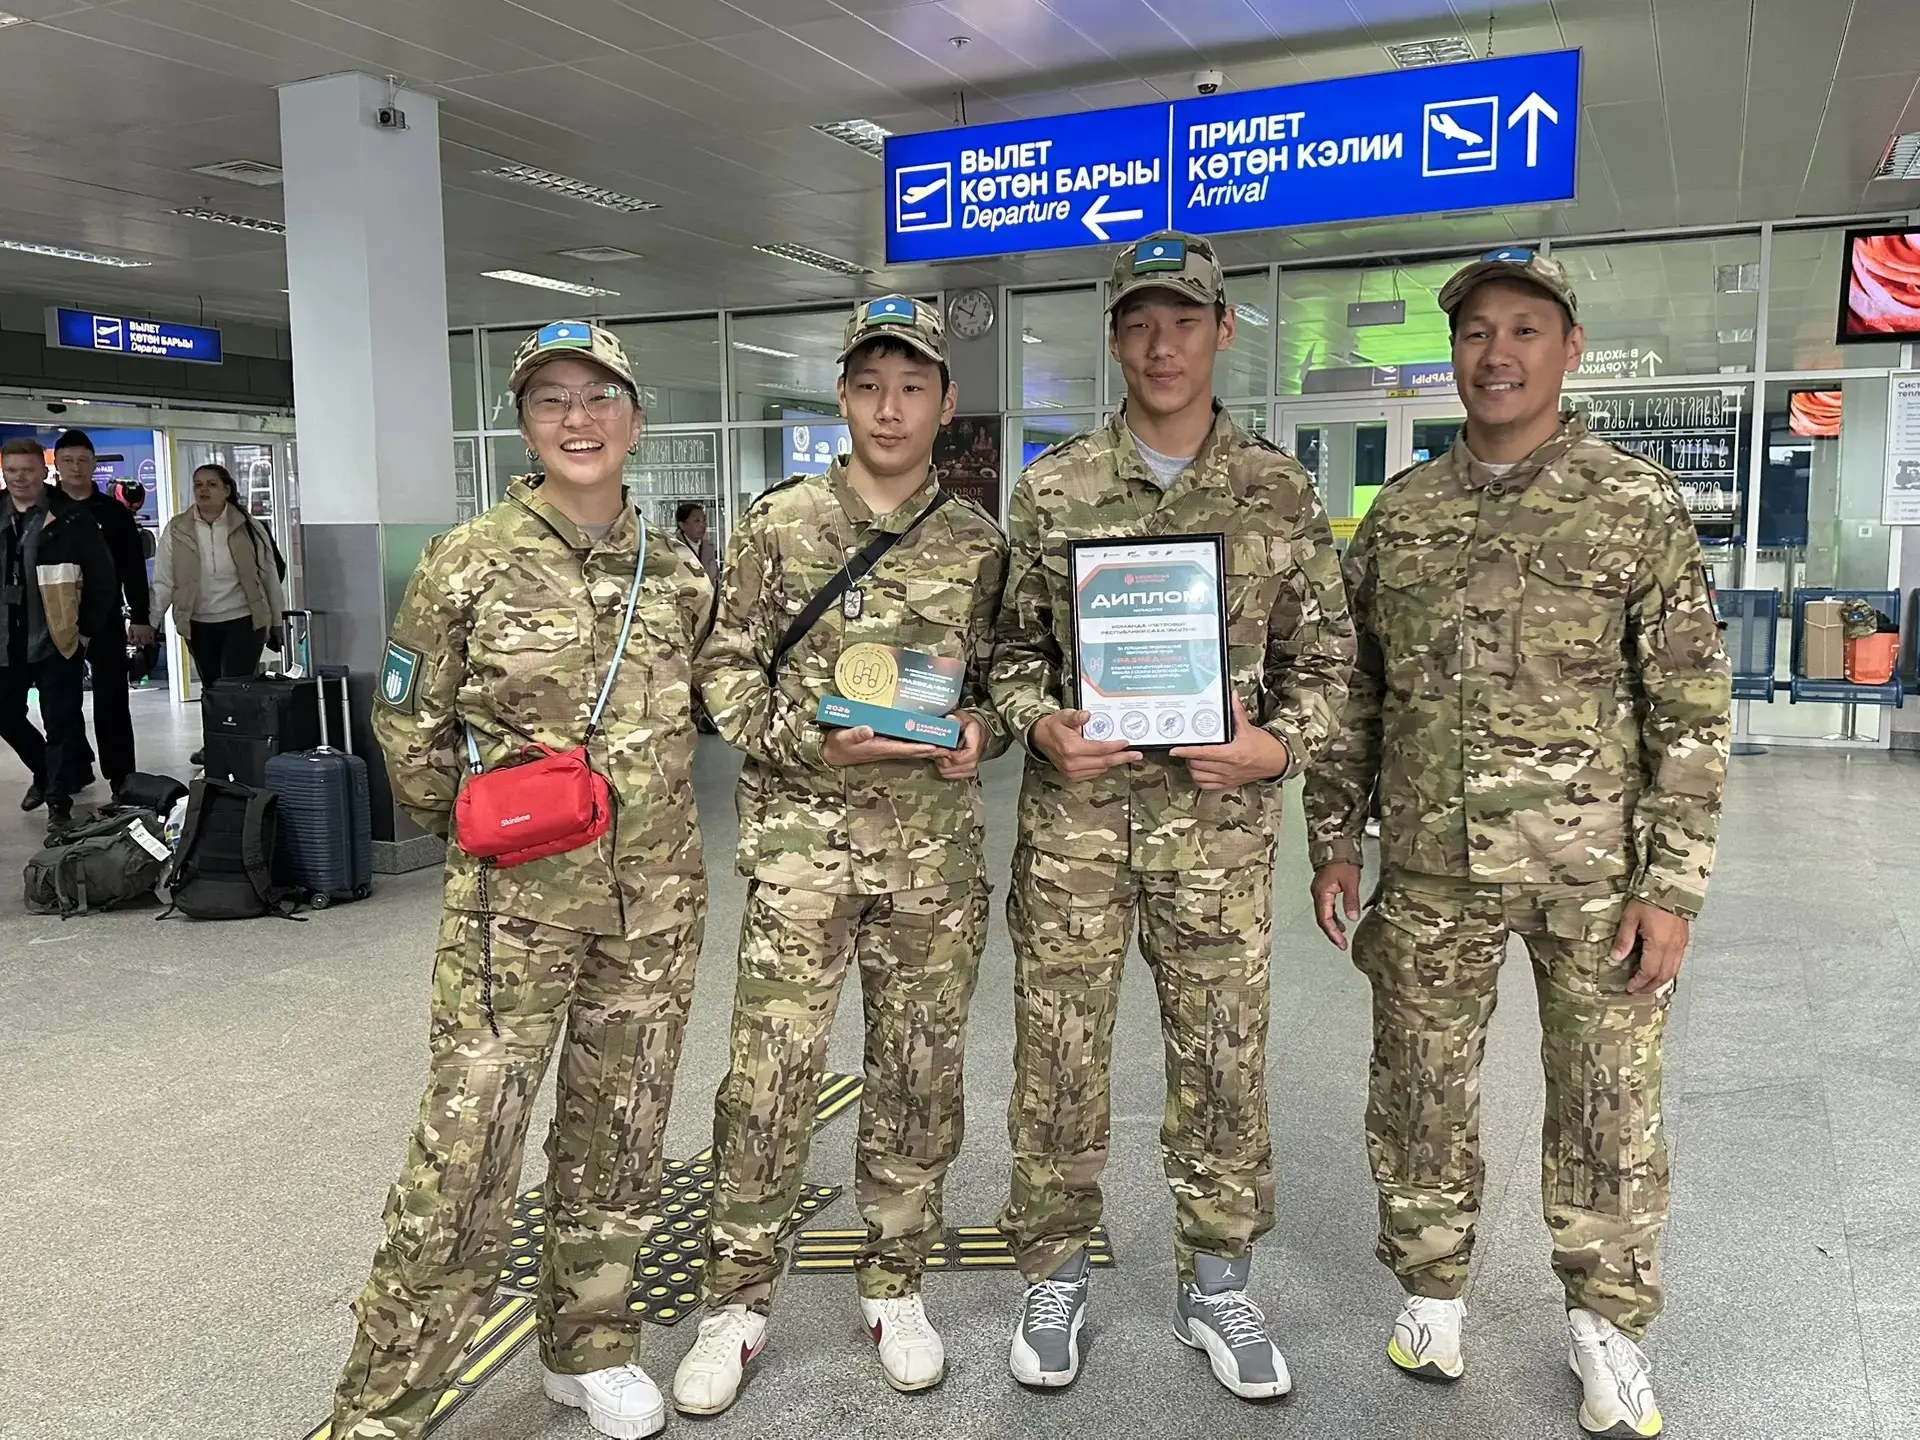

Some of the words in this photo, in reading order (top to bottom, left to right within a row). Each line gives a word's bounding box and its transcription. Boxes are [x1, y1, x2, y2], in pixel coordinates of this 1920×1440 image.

[1188, 112, 1305, 149] ПРИЛЕТ
[961, 140, 1052, 175] ВЫЛЕТ
[1188, 143, 1290, 181] КӨТӨН
[1297, 132, 1404, 168] КЭЛИИ
[961, 168, 1049, 203] КӨТӨН
[1056, 157, 1161, 193] БАРЫЫ
[1187, 176, 1269, 210] Arrival
[961, 198, 1071, 230] Departure
[129, 322, 160, 333] ВЫЛЕТ
[130, 333, 160, 345] КӨТӨН
[161, 337, 193, 349] БАРЫЫ
[131, 342, 167, 355] Departure
[1091, 588, 1205, 609] ДИПЛОМ
